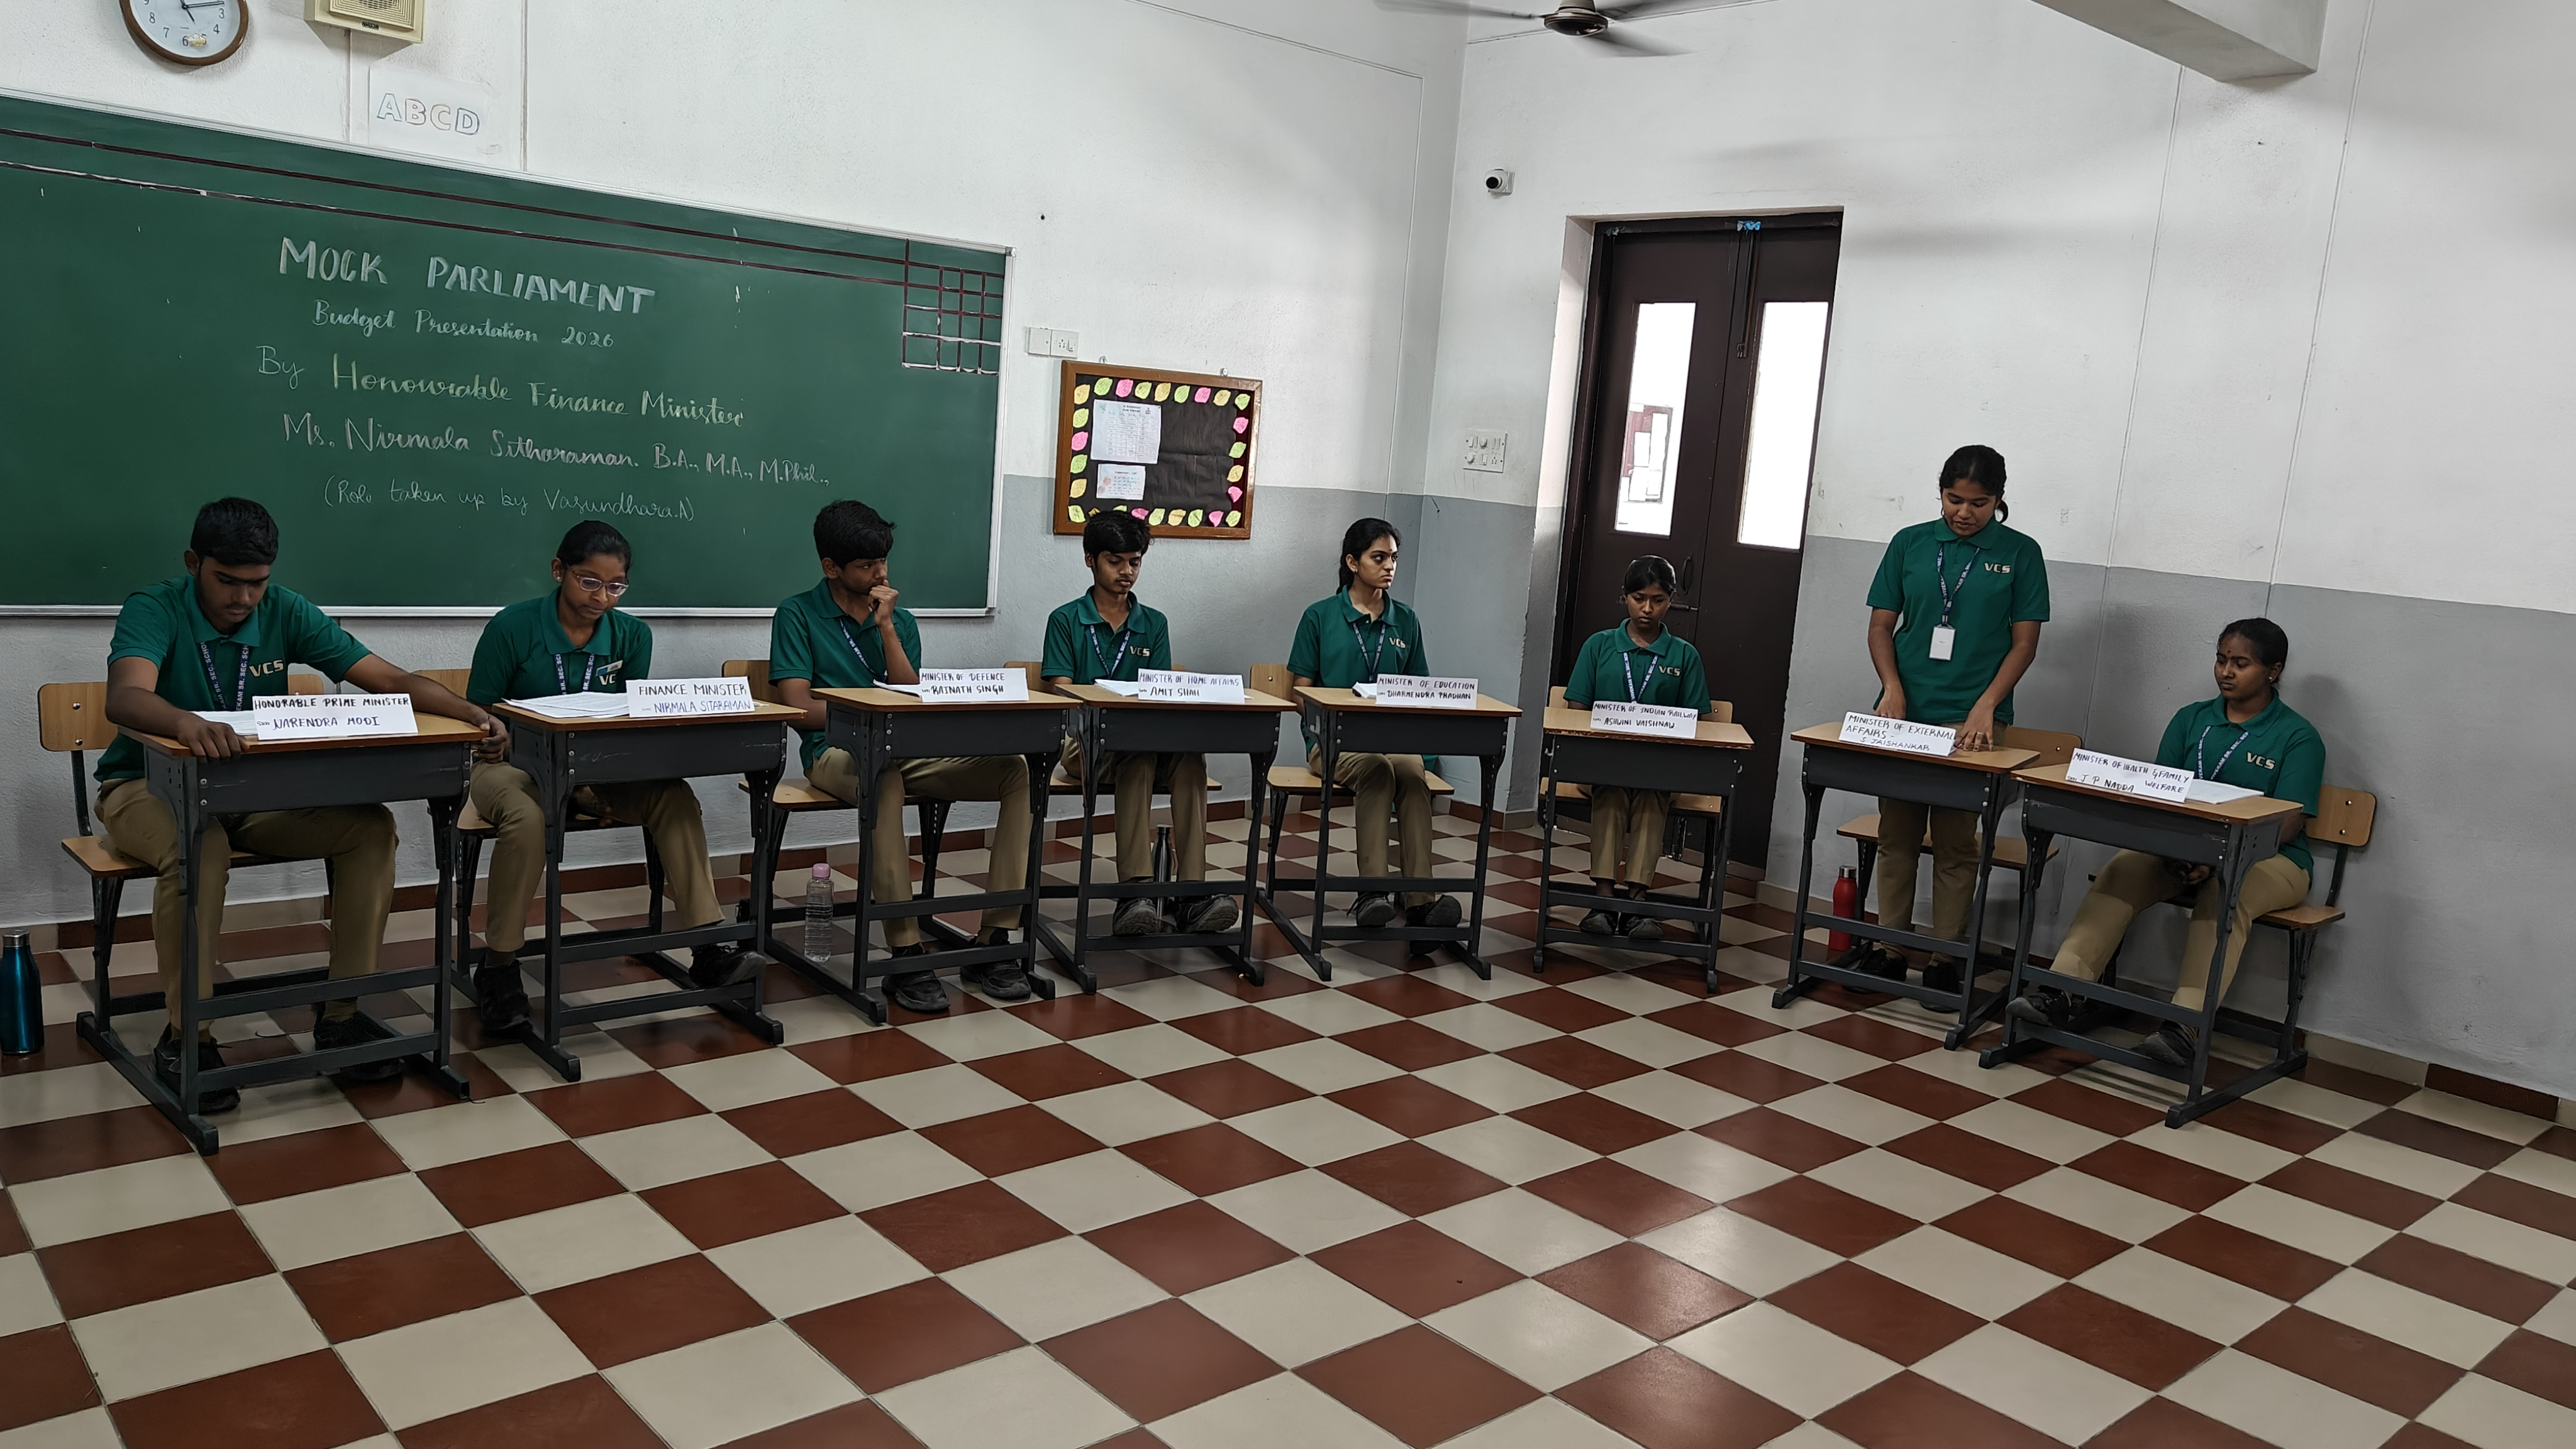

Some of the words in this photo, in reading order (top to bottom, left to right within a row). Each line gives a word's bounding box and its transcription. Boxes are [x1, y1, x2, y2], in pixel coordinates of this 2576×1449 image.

[149, 12, 156, 24] 8
[218, 8, 225, 19] 3
[163, 27, 170, 38] 7
[213, 24, 220, 35] 4
[182, 36, 189, 47] 6
[377, 92, 480, 136] ABCD
[279, 236, 388, 284] MOCK
[428, 256, 655, 314] PARLIAMENT
[312, 299, 396, 337] Budget
[415, 309, 539, 343] Presentation
[562, 326, 614, 348] 2026
[255, 345, 305, 390] By
[332, 353, 513, 401] Honourable
[528, 382, 628, 415] Finance
[641, 389, 743, 427] Minister
[284, 412, 335, 447] Ms.
[345, 417, 470, 452] Nirmala
[652, 443, 699, 472] B.A.,
[706, 452, 753, 480] M.A.,
[759, 458, 830, 486] M.Phil.,
[325, 475, 372, 508] (Role
[390, 479, 447, 503] taken
[458, 492, 486, 511] up
[501, 487, 528, 516] by
[1984, 562, 2011, 574] VCS
[1389, 637, 1406, 649] VCS
[1130, 646, 1150, 657] VCS
[248, 659, 284, 677] VCS
[1658, 665, 1681, 676] VCS
[599, 674, 616, 685] VC
[921, 672, 954, 681] MINISTER
[969, 673, 1005, 681] DEFENCE
[1139, 672, 1172, 684] MINISTER
[1175, 675, 1184, 683] OF
[1188, 675, 1207, 685] HOME
[1210, 678, 1239, 686] AFFAIRS
[639, 684, 687, 696] FINANCE
[694, 684, 747, 696] MINISTER
[976, 685, 1004, 695] SINGH
[1378, 677, 1413, 686] MINISTER
[1419, 680, 1430, 688] OF
[1434, 680, 1475, 691] EDUCATION
[1150, 686, 1173, 697] AMIT
[1387, 690, 1435, 698] DHARMENDRA
[1438, 691, 1471, 700] PRADHAN
[254, 697, 317, 710] HONORABLE
[322, 698, 357, 708] PRIME
[363, 697, 409, 706] MINISTER
[654, 702, 697, 713] NIRMALA
[700, 700, 751, 712] SITARAMAN
[1594, 703, 1626, 712] MINISTER
[1667, 709, 1697, 720] RAILWAY
[272, 717, 338, 730] NARENDRA
[347, 716, 380, 726] MODI
[1604, 717, 1632, 726] ASHWINI
[1848, 715, 1890, 729] MINISTER
[1894, 722, 1905, 731] OF
[1908, 725, 1955, 740] EXTERNAL
[1846, 724, 1887, 739] AFFAIRS
[1870, 738, 1930, 751] JAISHANKAR
[2073, 752, 2109, 766] MINISTER
[2112, 760, 2123, 769] OF
[2123, 763, 2149, 774] HEALTH
[2247, 752, 2275, 770] VCS
[2081, 774, 2089, 782] J
[2092, 775, 2100, 785] P
[2104, 779, 2135, 792] NADDA
[2145, 780, 2185, 793] WELFARE
